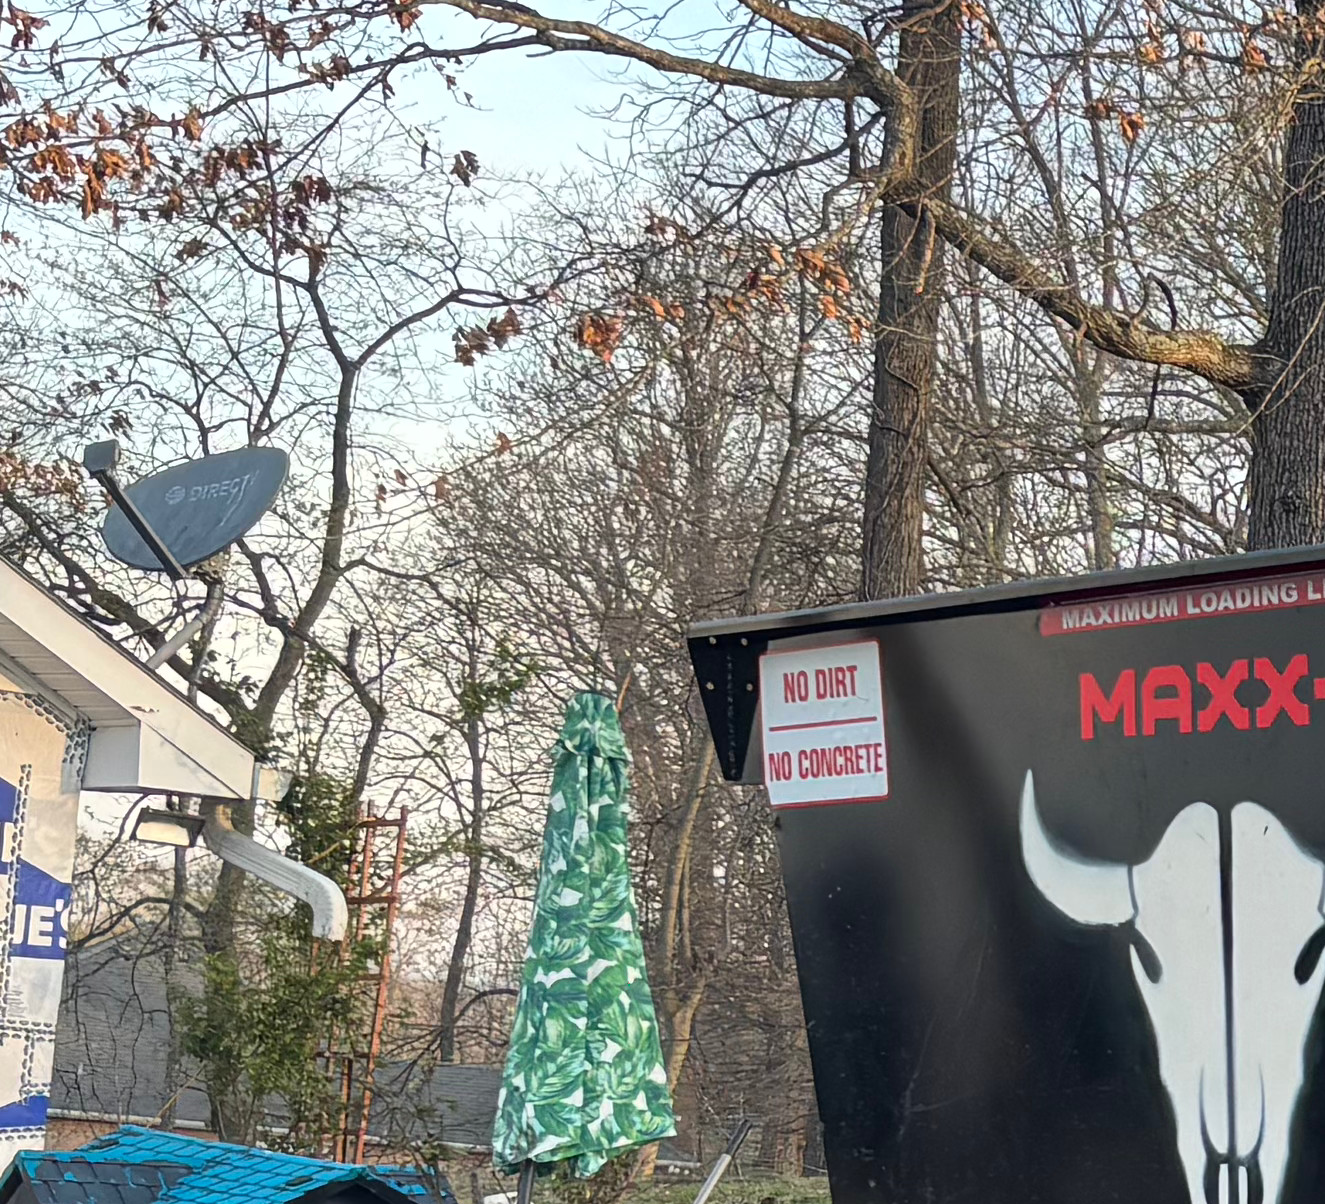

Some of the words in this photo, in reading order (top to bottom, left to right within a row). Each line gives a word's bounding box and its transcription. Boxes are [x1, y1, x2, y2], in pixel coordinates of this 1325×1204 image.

[1061, 597, 1179, 630] MAXIMUM
[1186, 583, 1299, 615] LOADING
[783, 670, 809, 704] NO
[815, 664, 858, 700] DIRT
[769, 751, 792, 782] NO
[797, 742, 884, 780] CONCRETE
